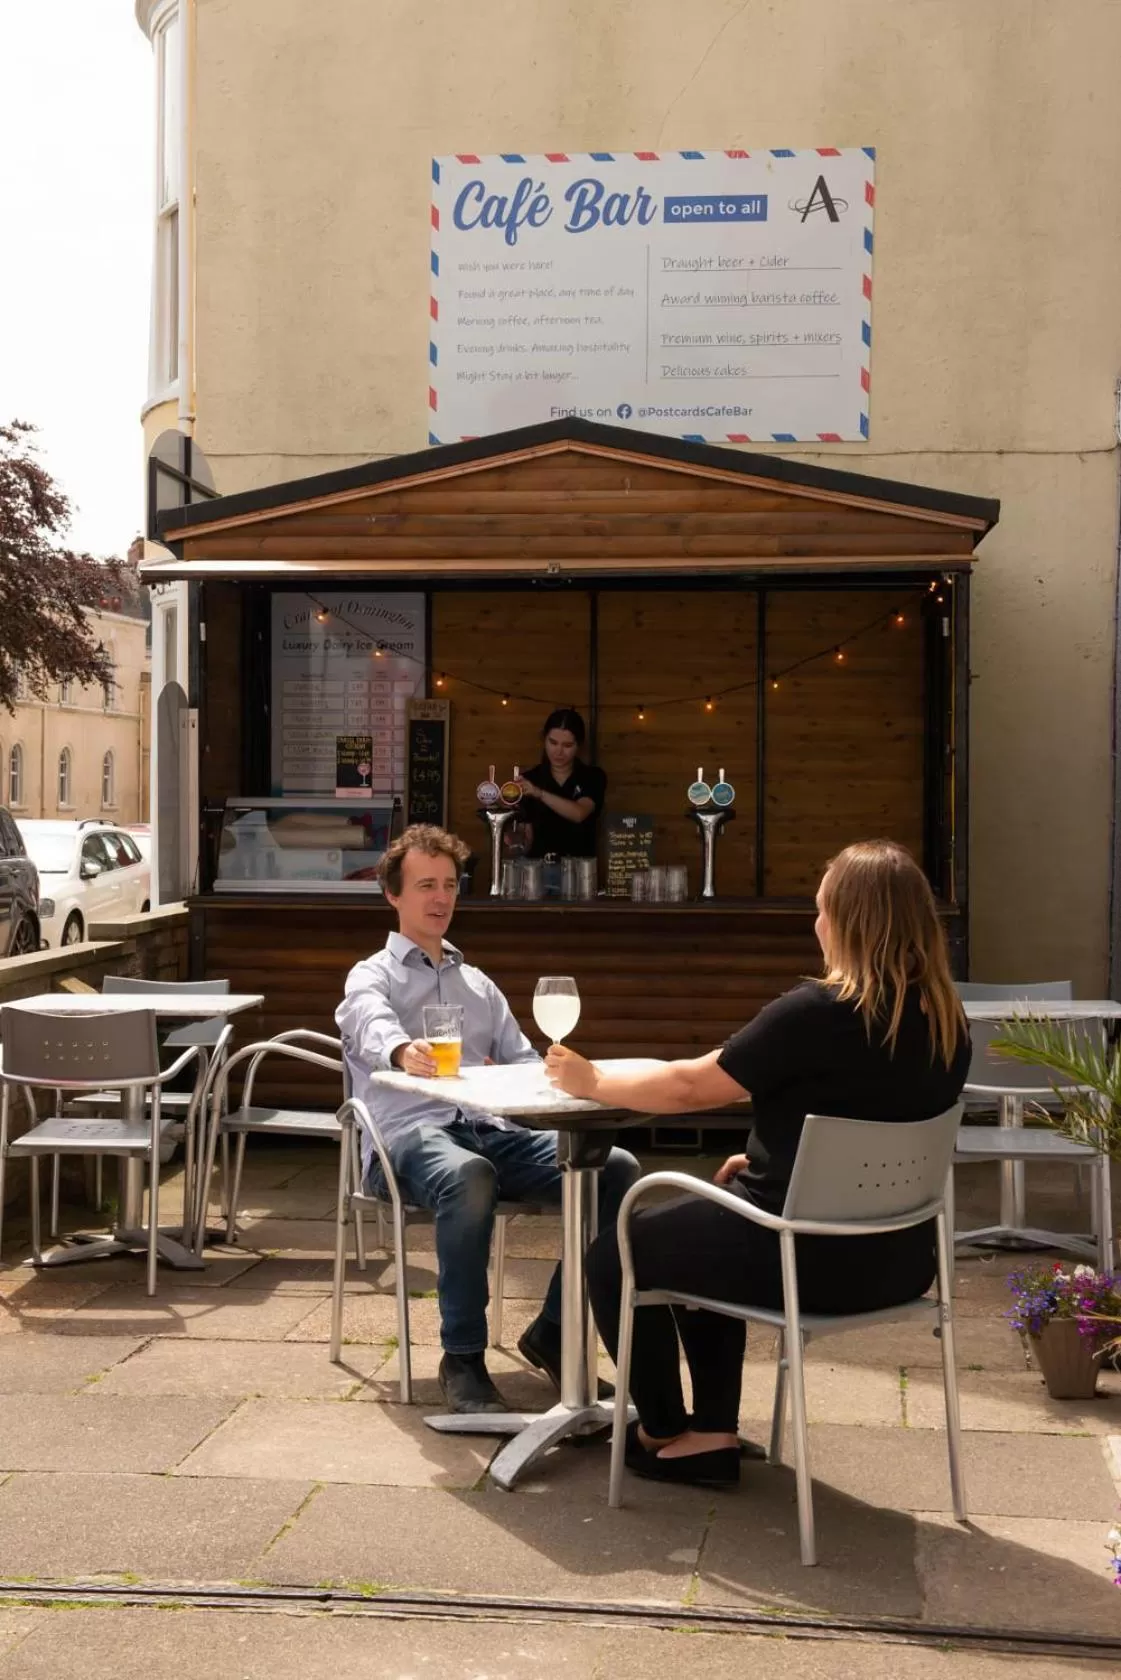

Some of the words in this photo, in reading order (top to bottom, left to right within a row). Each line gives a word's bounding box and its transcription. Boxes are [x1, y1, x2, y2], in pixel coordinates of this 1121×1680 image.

[453, 177, 553, 246] Café
[564, 178, 657, 234] Bar
[671, 202, 713, 217] open
[719, 202, 736, 215] to
[741, 200, 760, 214] all
[502, 262, 525, 271] were
[661, 255, 715, 273] Draught
[718, 255, 745, 267] beer
[458, 289, 486, 299] Found
[498, 289, 525, 301] great
[558, 289, 576, 300] any
[579, 288, 601, 297] time
[603, 285, 615, 297] of
[660, 292, 701, 307] Award
[751, 291, 798, 304] barista
[800, 289, 838, 304] coffee
[457, 316, 496, 329] Morning
[533, 315, 581, 326] afternoon
[660, 333, 713, 345] Premium
[750, 331, 789, 347] spirits
[803, 332, 842, 344] mixers
[457, 344, 496, 356] Evening
[531, 343, 574, 356] Amazing
[456, 370, 485, 384] Might
[660, 364, 711, 377] Delicious
[714, 362, 748, 377] cakes
[550, 405, 576, 417] Find
[579, 408, 593, 417] us
[597, 408, 612, 417] on
[638, 406, 753, 418] @PostcardsCafeBar
[282, 639, 320, 653] Luxury
[356, 640, 373, 650] Ice
